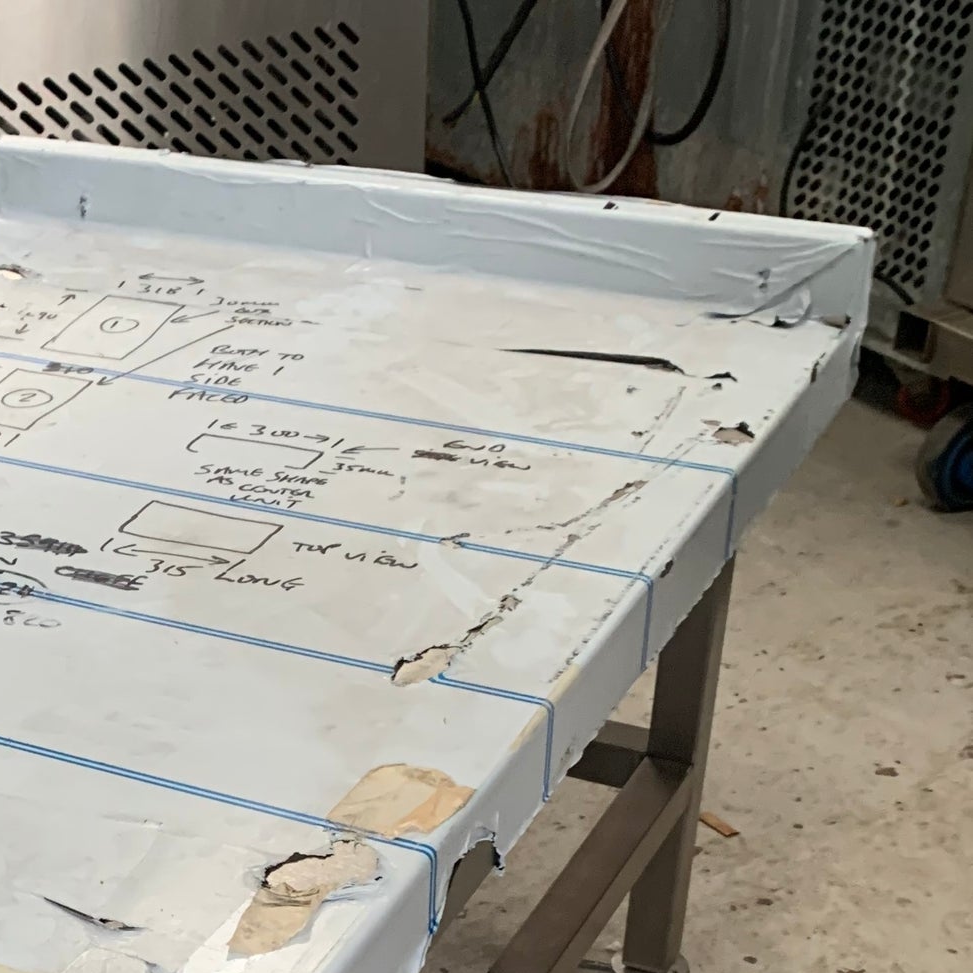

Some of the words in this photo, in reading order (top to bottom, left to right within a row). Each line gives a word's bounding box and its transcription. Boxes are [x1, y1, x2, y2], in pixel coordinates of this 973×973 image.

[278, 352, 305, 361] TO
[192, 358, 259, 372] HAVE
[194, 464, 263, 477] SAME
[266, 471, 329, 485] SHAPE
[206, 475, 234, 485] AS
[292, 541, 342, 555] TOP
[214, 558, 305, 591] LONG
